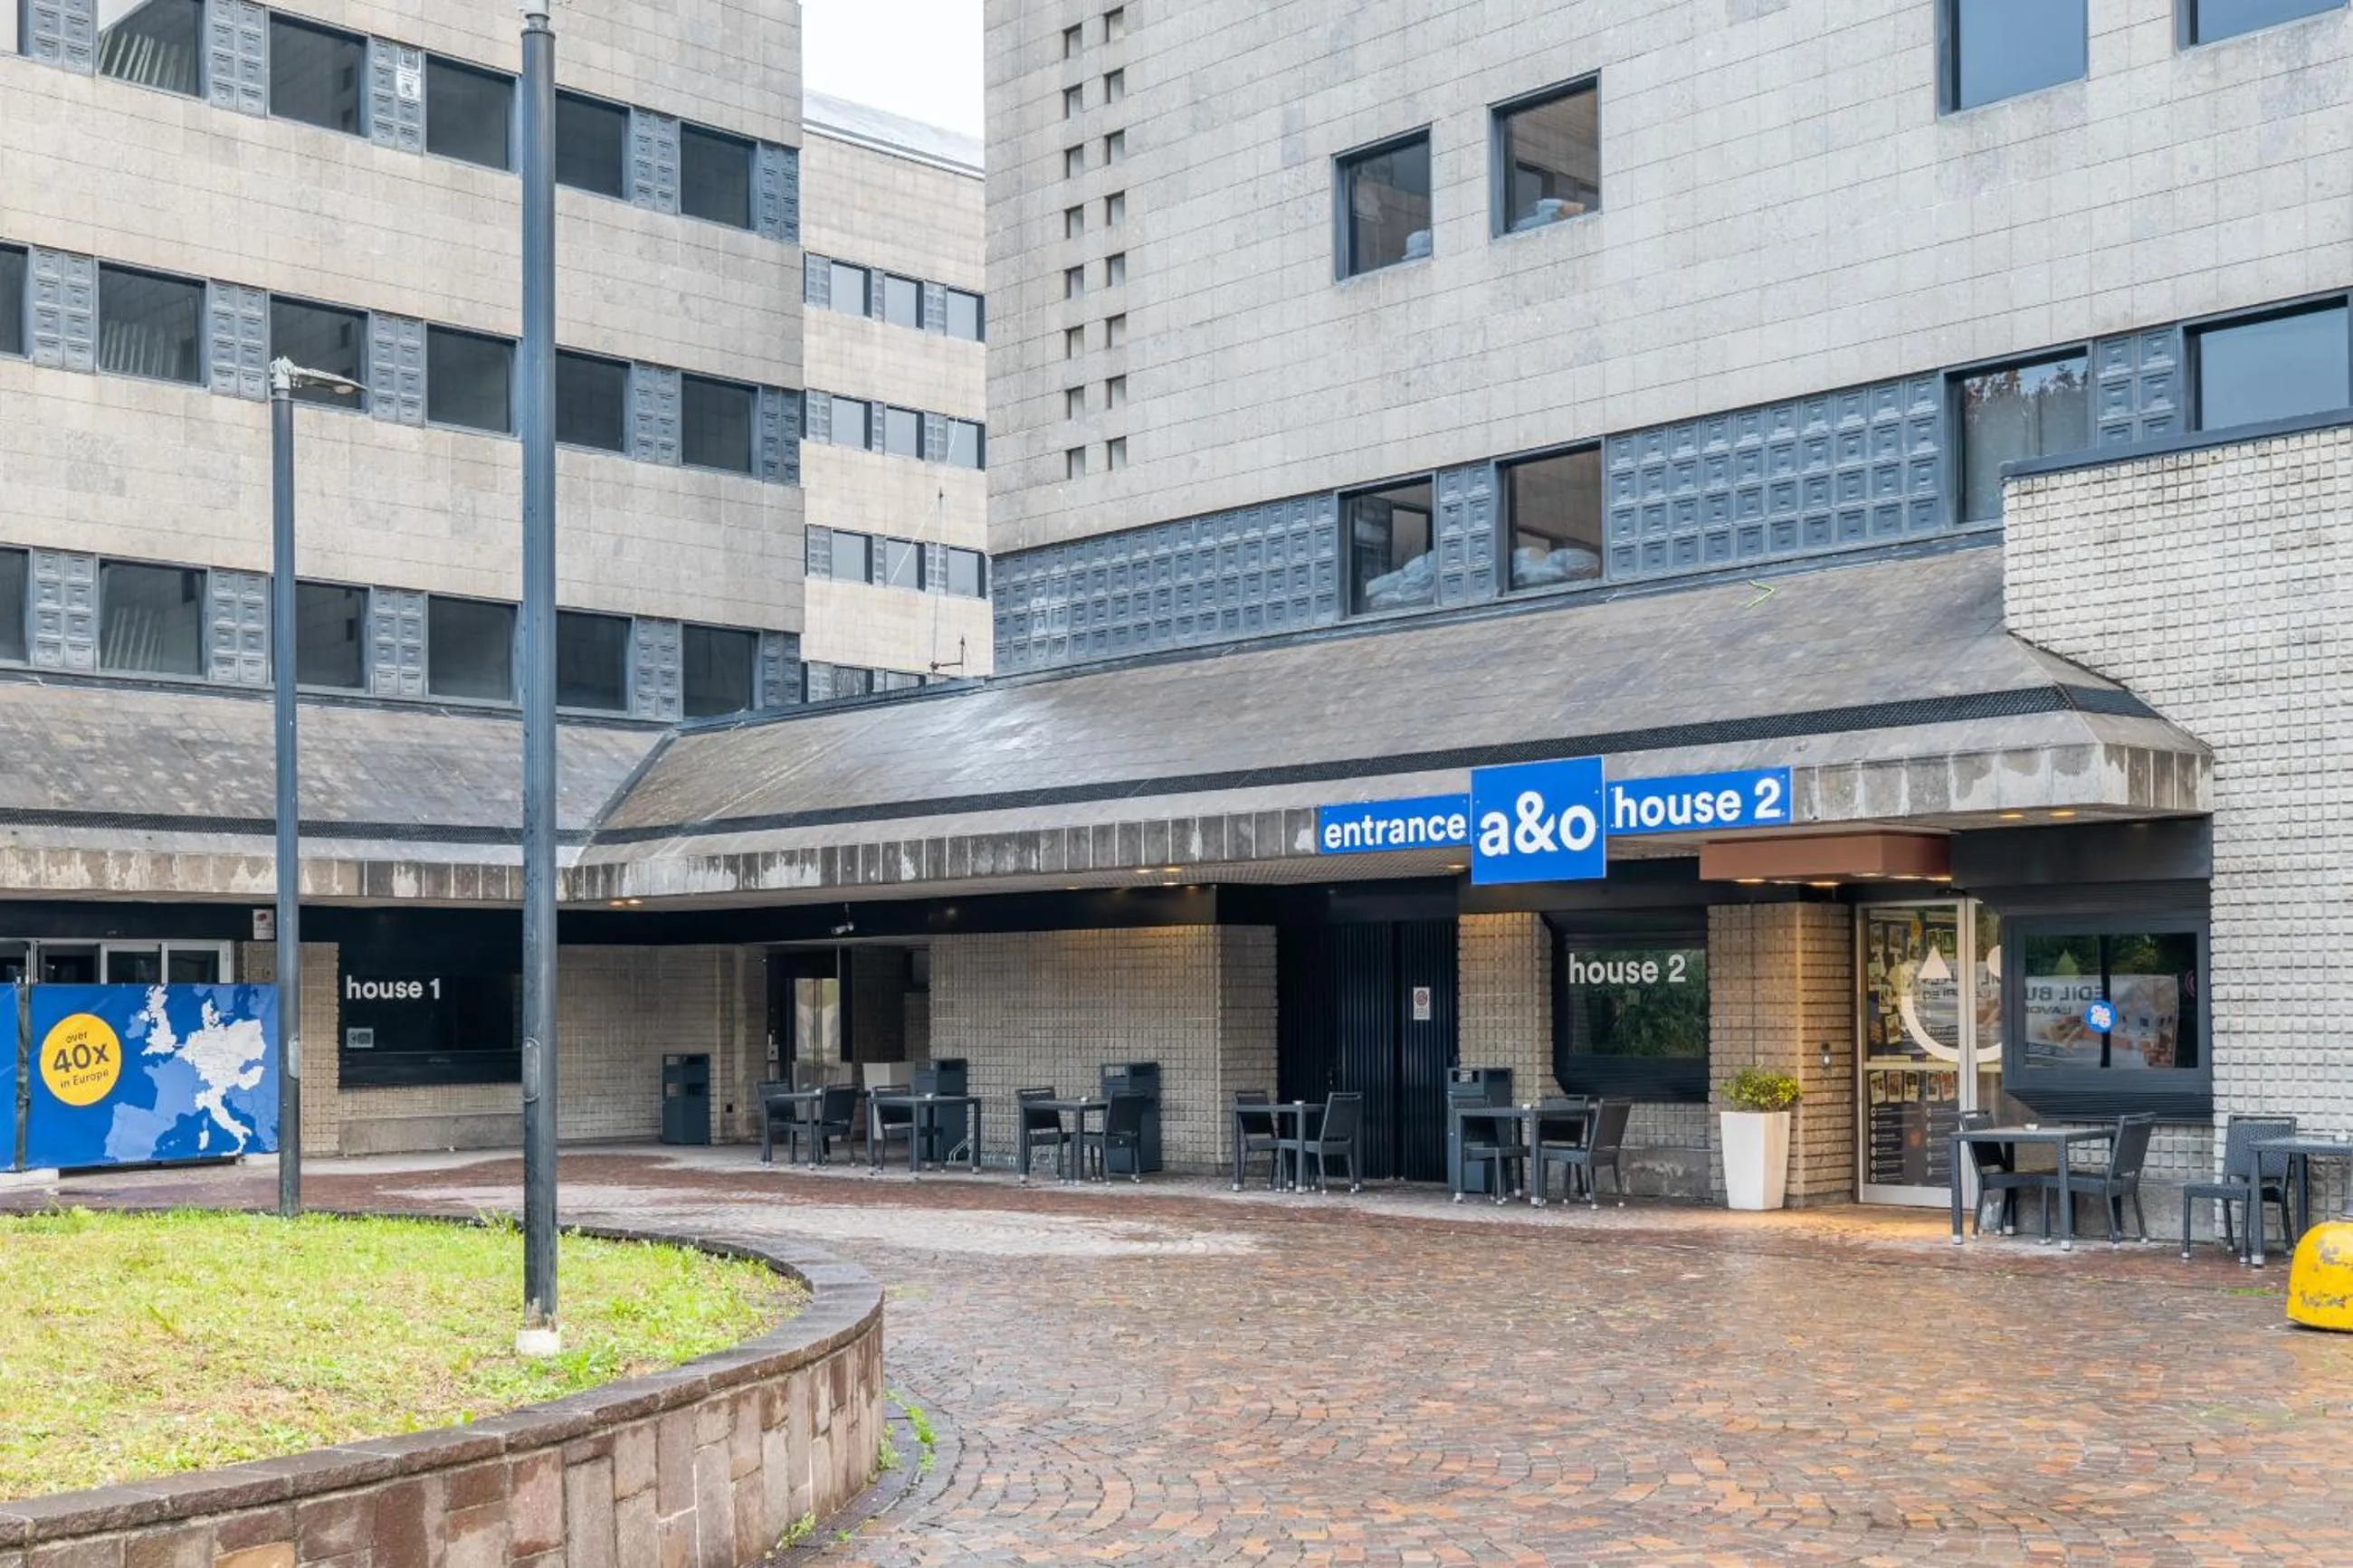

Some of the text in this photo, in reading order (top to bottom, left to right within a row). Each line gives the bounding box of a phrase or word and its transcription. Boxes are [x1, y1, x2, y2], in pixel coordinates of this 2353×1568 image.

[1615, 777, 1782, 829] house 2
[1324, 813, 1467, 850] entrance
[1479, 791, 1596, 858] a&o
[1568, 953, 1686, 984] house 2
[346, 974, 440, 1000] house 1
[65, 1031, 88, 1043] over
[52, 1042, 110, 1073] 40x
[60, 1069, 110, 1088] in Europe
